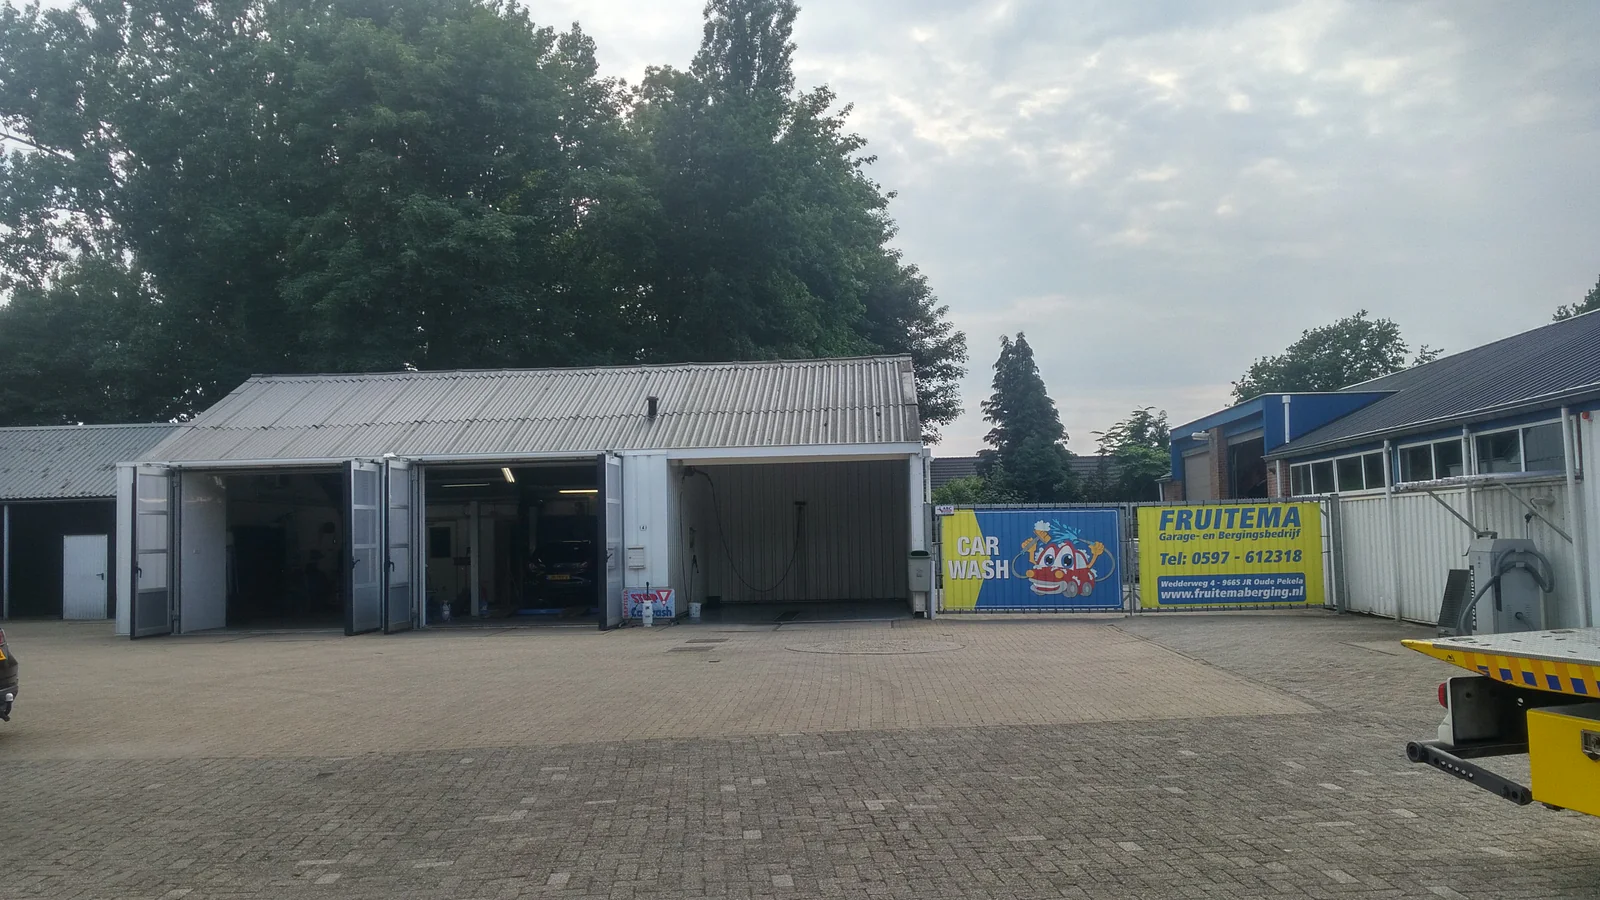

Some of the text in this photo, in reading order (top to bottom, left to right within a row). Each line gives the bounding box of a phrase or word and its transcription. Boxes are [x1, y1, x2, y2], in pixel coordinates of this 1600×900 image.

[1159, 507, 1301, 531] FRUITEMA
[1159, 529, 1301, 542] Garage- en Bergingsbedrijf
[957, 536, 1000, 556] CAR
[1160, 552, 1187, 565] Tel:
[1191, 551, 1230, 564] 0597
[1245, 549, 1303, 563] 612318
[948, 560, 1009, 580] WASH
[1161, 580, 1208, 588] Wedderweg
[1242, 578, 1252, 586] JR
[1277, 577, 1303, 585] Pekela
[1161, 585, 1304, 599] www.fruitemaberging.nl
[631, 606, 672, 617] Caash
